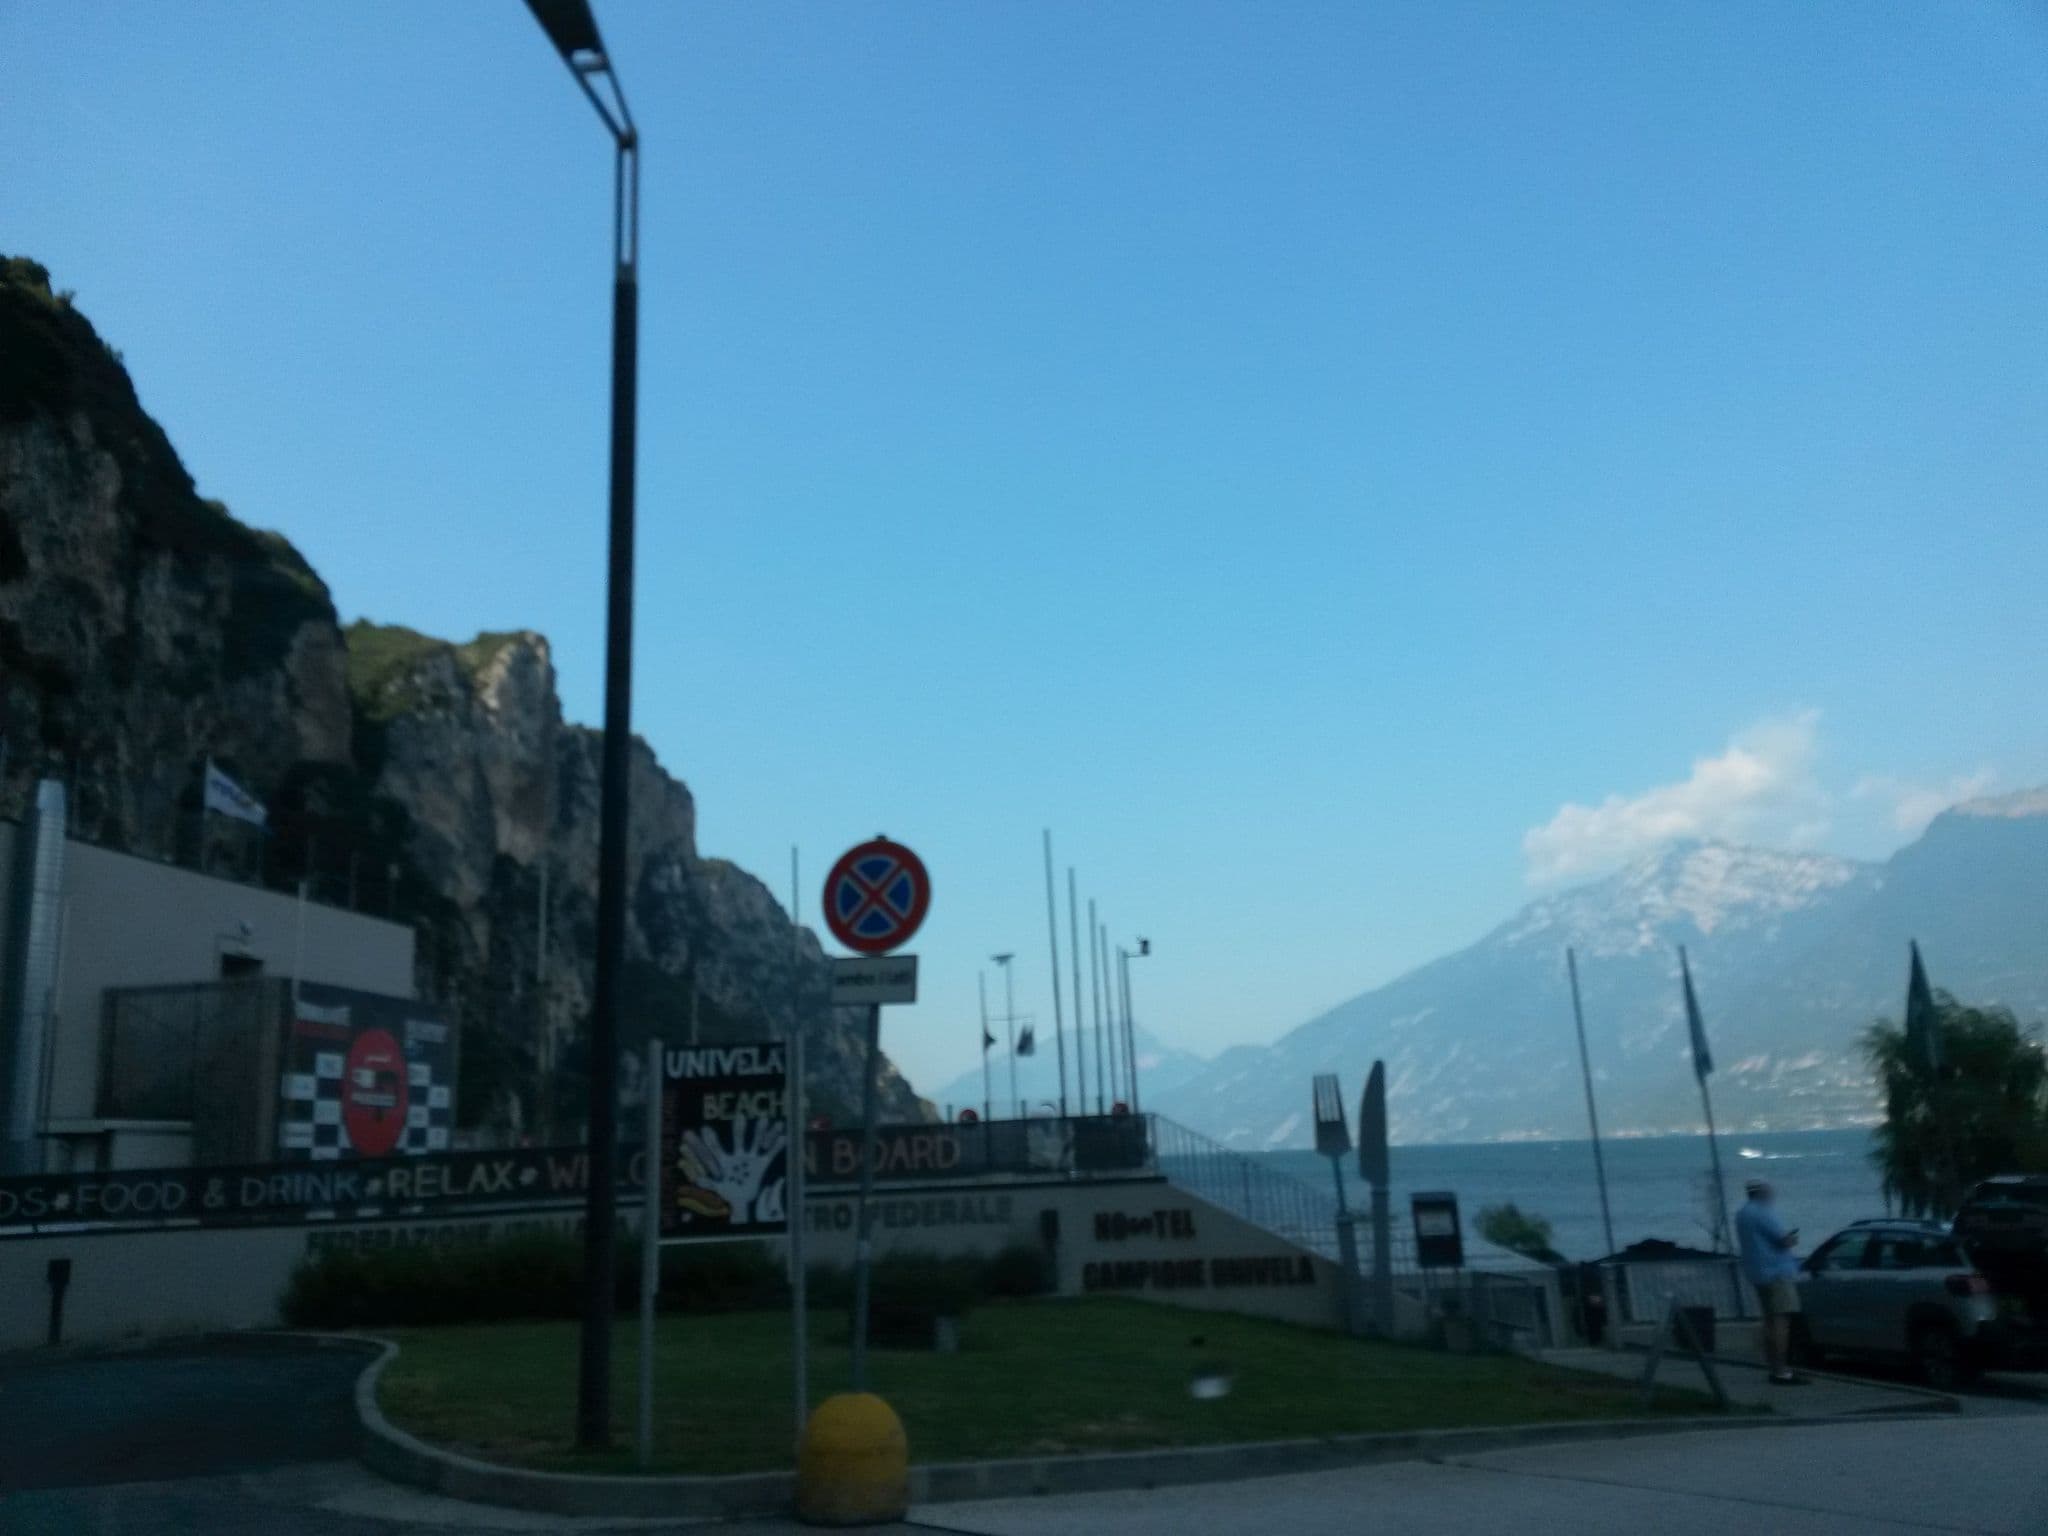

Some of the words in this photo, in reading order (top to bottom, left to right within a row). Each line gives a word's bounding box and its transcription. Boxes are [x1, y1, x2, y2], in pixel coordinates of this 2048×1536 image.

[664, 1045, 785, 1080] UNIVELA
[701, 1089, 786, 1121] BEACH
[76, 1180, 188, 1214] FOOD
[203, 1176, 225, 1209] &
[240, 1170, 357, 1207] DRINK
[387, 1158, 516, 1199] RELAX
